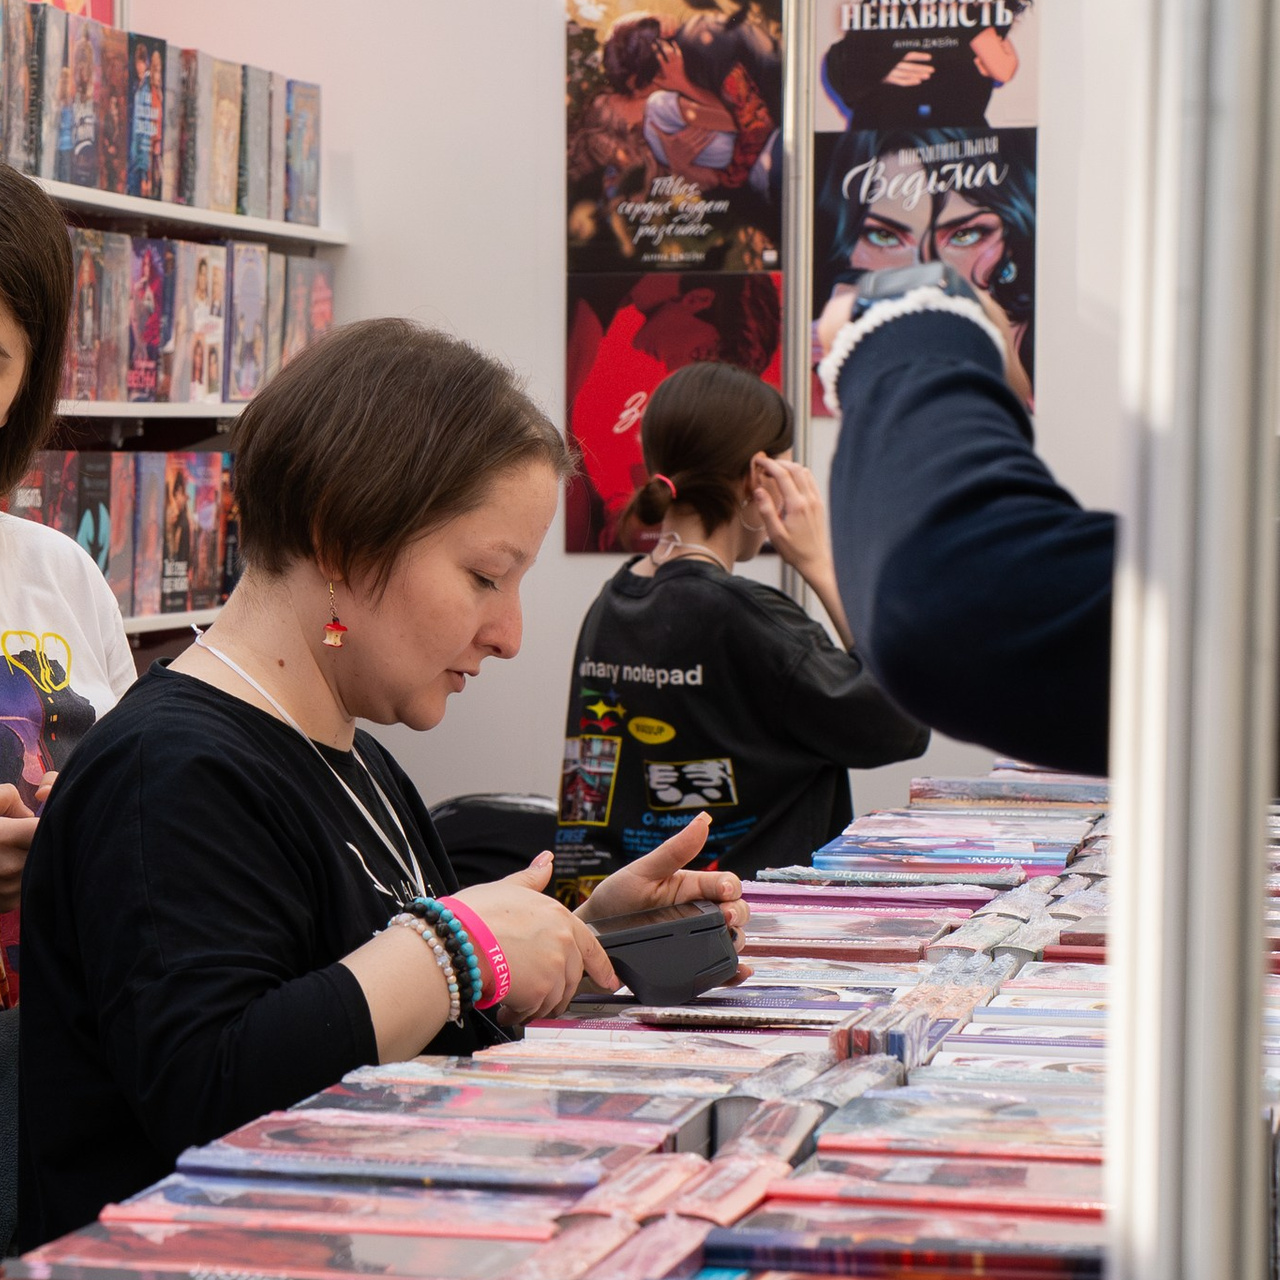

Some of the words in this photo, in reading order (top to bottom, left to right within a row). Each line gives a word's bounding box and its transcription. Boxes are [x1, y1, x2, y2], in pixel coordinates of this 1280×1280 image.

[841, 154, 1009, 212] Ведьма
[623, 664, 703, 689] notepad
[488, 943, 509, 1001] TREND
